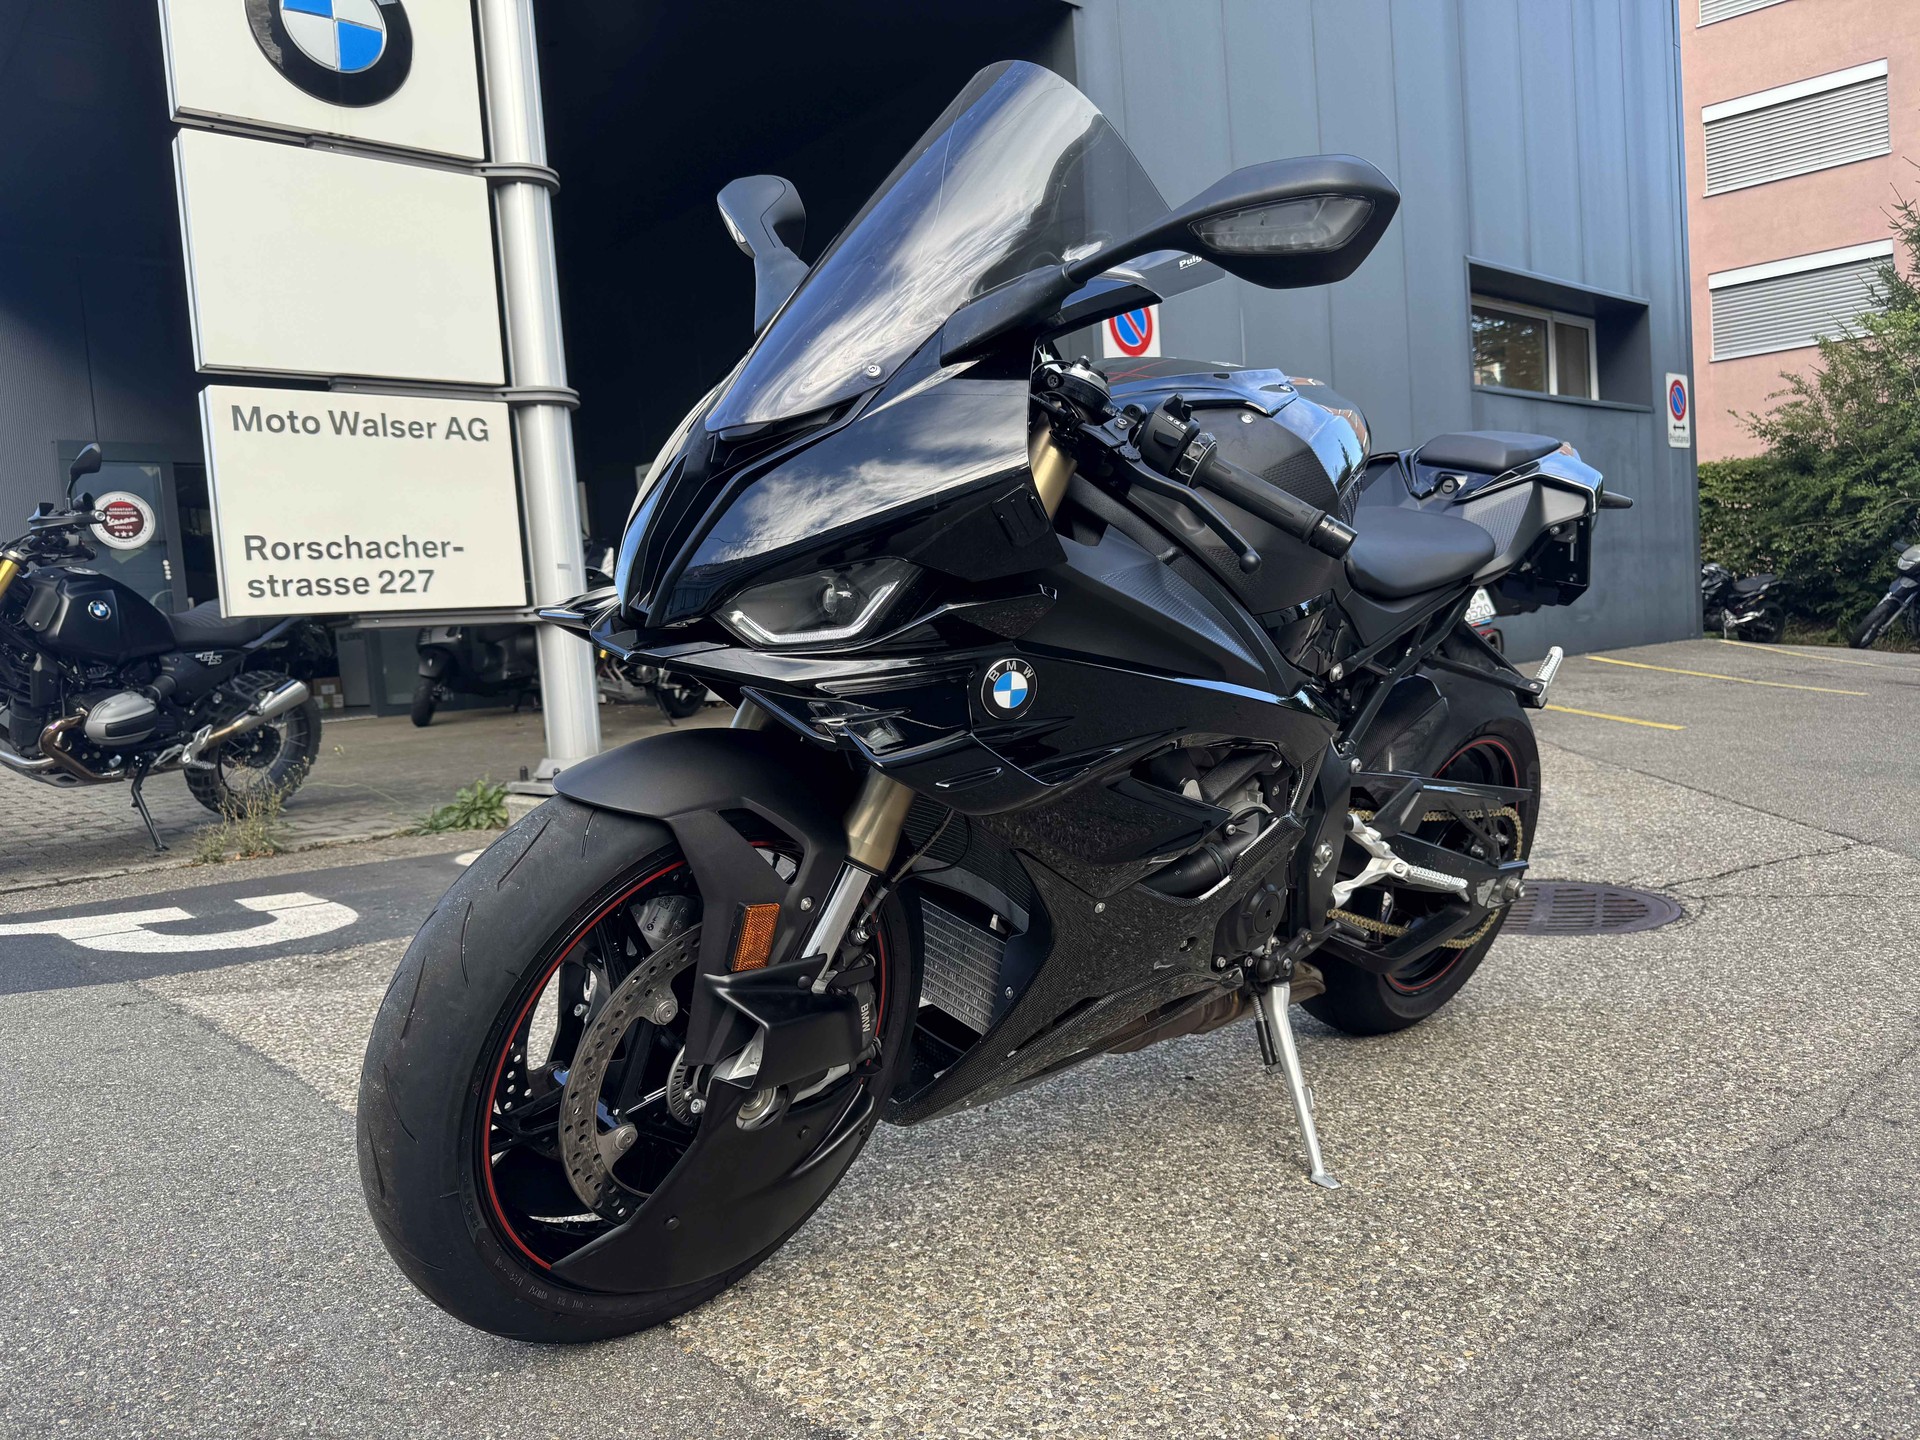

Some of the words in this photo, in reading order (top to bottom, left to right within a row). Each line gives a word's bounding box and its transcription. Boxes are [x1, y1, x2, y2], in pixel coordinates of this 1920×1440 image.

[1179, 255, 1202, 267] Puig
[231, 404, 321, 435] Moto
[328, 409, 437, 439] Walser
[444, 416, 490, 442] AG
[244, 534, 464, 561] Rorschacher-
[247, 574, 370, 598] strasse
[378, 569, 435, 594] 227
[988, 660, 1034, 682] BMW
[860, 1003, 871, 1033] BMW
